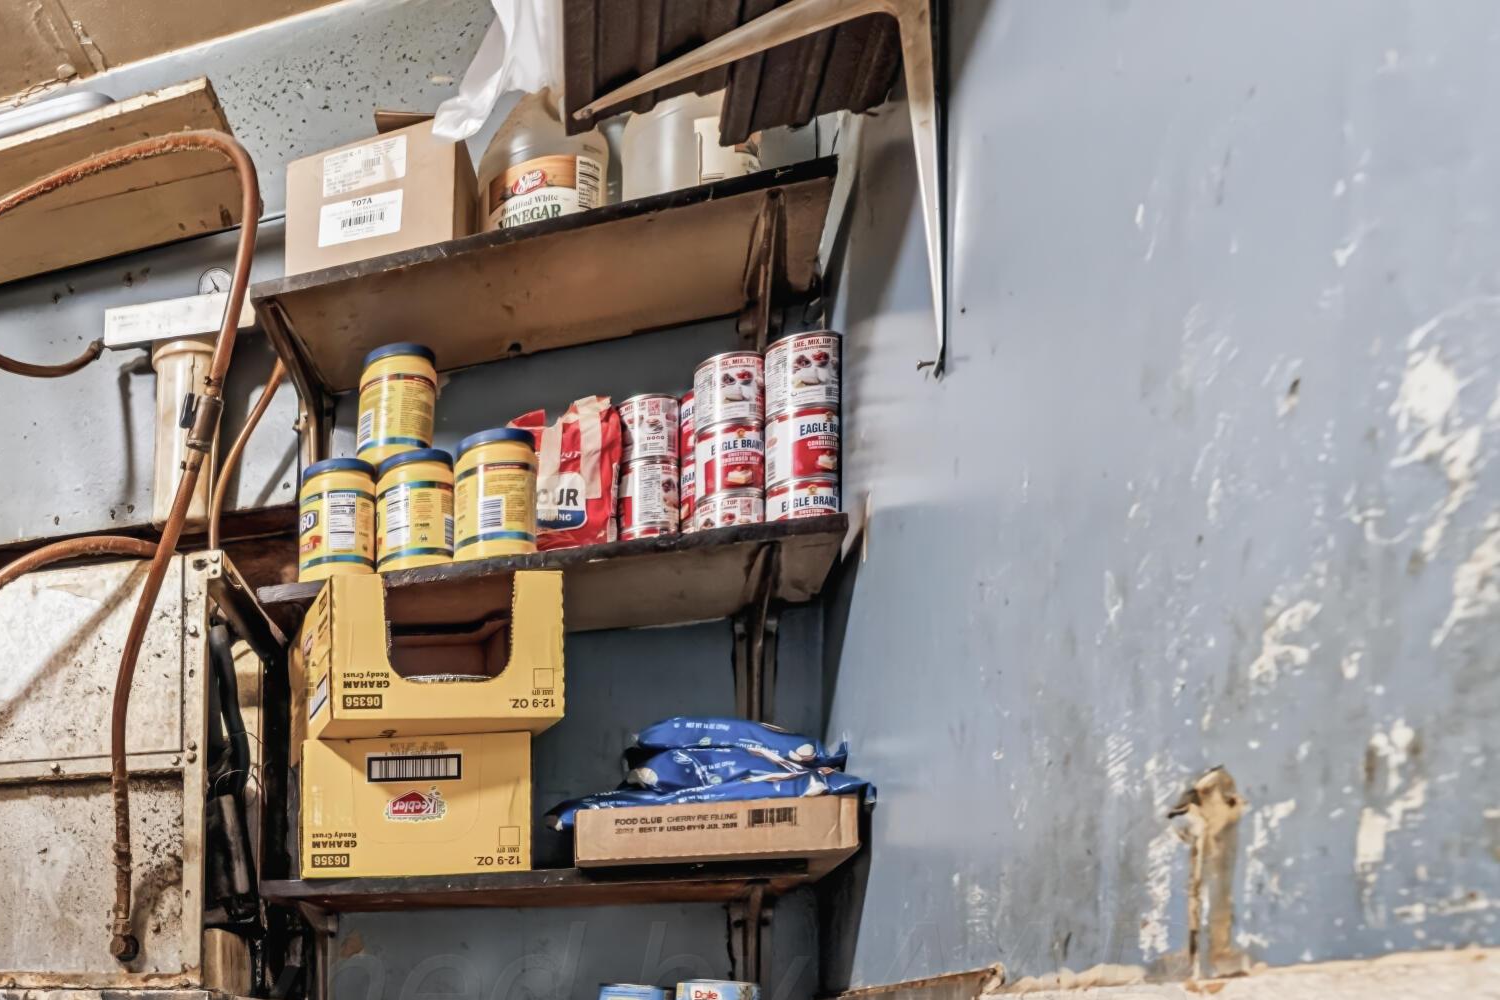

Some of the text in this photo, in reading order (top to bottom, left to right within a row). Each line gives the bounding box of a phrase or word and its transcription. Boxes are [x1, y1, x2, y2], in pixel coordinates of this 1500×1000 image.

[351, 197, 373, 207] 707A
[534, 194, 560, 205] White
[498, 203, 563, 229] VINEGAR
[800, 422, 827, 436] EAGLE
[365, 671, 390, 679] Ready
[343, 680, 390, 689] GRAHAM
[345, 696, 381, 707] 06356
[509, 698, 556, 709] OZ. 12-9
[392, 799, 438, 815] Keebler
[614, 812, 738, 827] FOOD CLUB CHERRY PIE FILLING
[334, 832, 357, 840] Ready
[311, 840, 357, 849] GRAHAM
[314, 855, 348, 867] 06356
[474, 855, 522, 867] OZ. 12-9
[695, 990, 718, 1000] Dole
